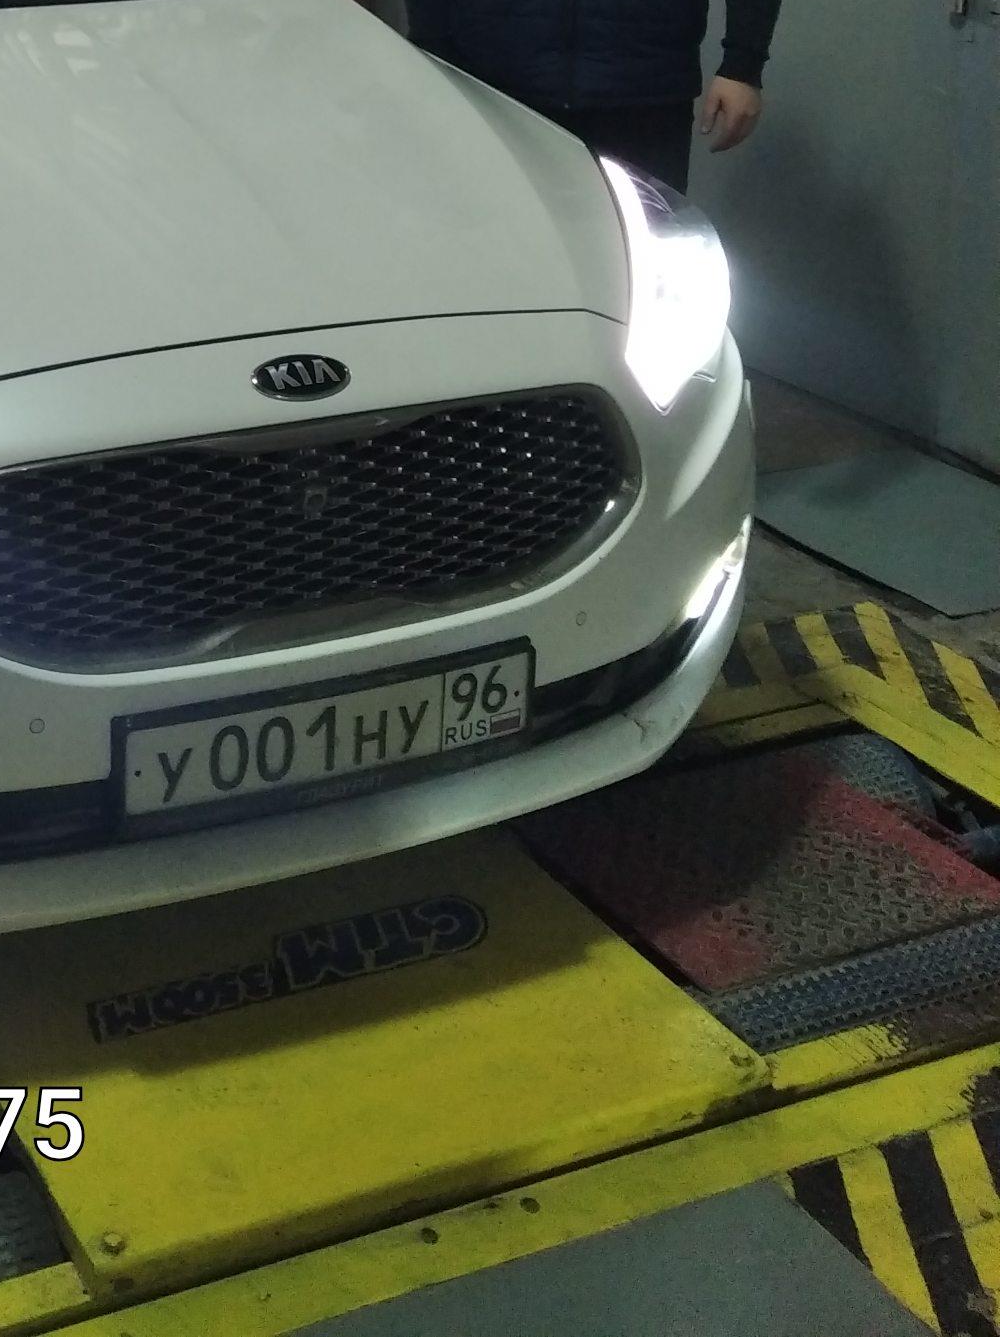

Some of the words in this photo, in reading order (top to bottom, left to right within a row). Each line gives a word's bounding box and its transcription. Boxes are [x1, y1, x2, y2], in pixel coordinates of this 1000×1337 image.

[264, 358, 341, 391] KIA
[450, 665, 508, 722] 96
[445, 720, 488, 747] RUS
